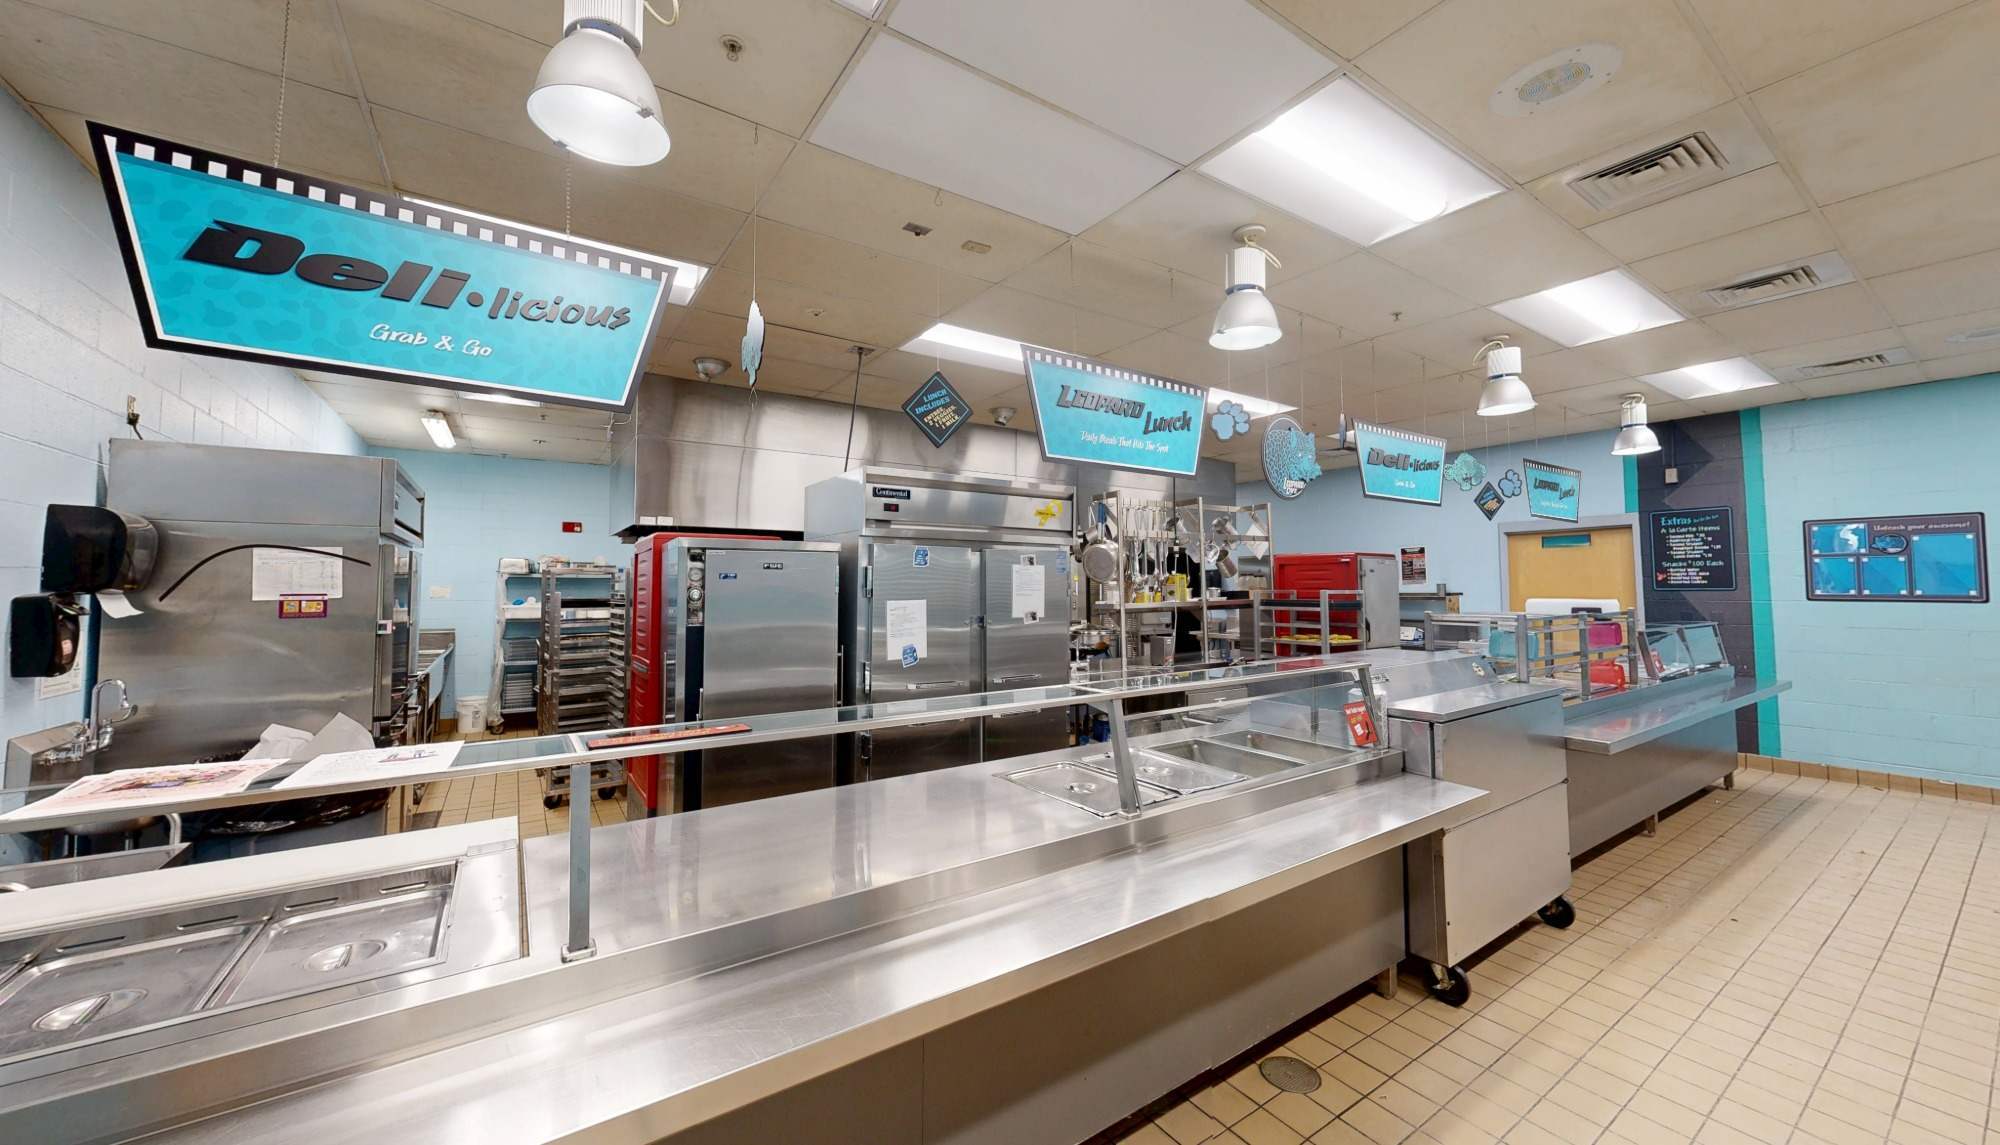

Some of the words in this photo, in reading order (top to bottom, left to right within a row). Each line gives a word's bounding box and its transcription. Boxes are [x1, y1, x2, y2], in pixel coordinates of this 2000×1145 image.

[369, 323, 428, 346] Grab
[434, 334, 454, 352] &
[462, 338, 492, 357] Go
[923, 388, 948, 402] LUNCH
[915, 396, 950, 414] INCLUDES
[1143, 410, 1192, 434] Lunch
[1660, 516, 1692, 526] Extras
